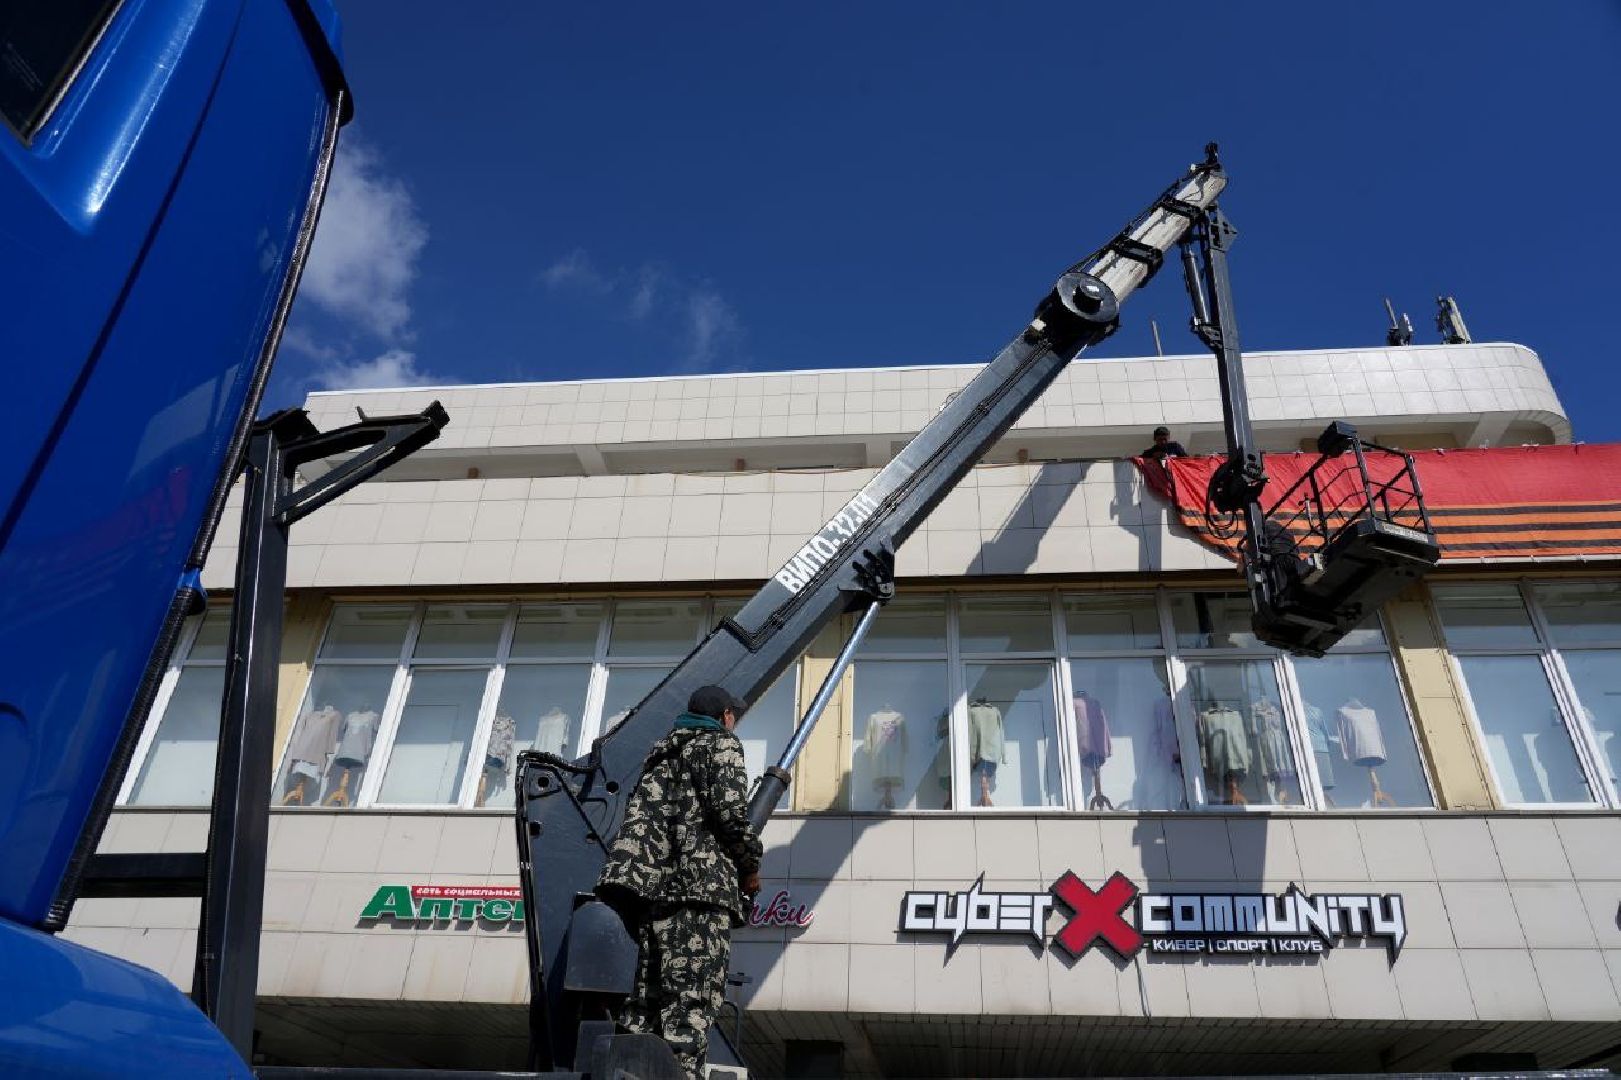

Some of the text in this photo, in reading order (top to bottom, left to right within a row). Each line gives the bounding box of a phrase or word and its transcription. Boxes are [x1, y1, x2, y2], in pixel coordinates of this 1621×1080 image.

[1152, 938, 1324, 952] КИБЕР СПОРТ КЛУБ
